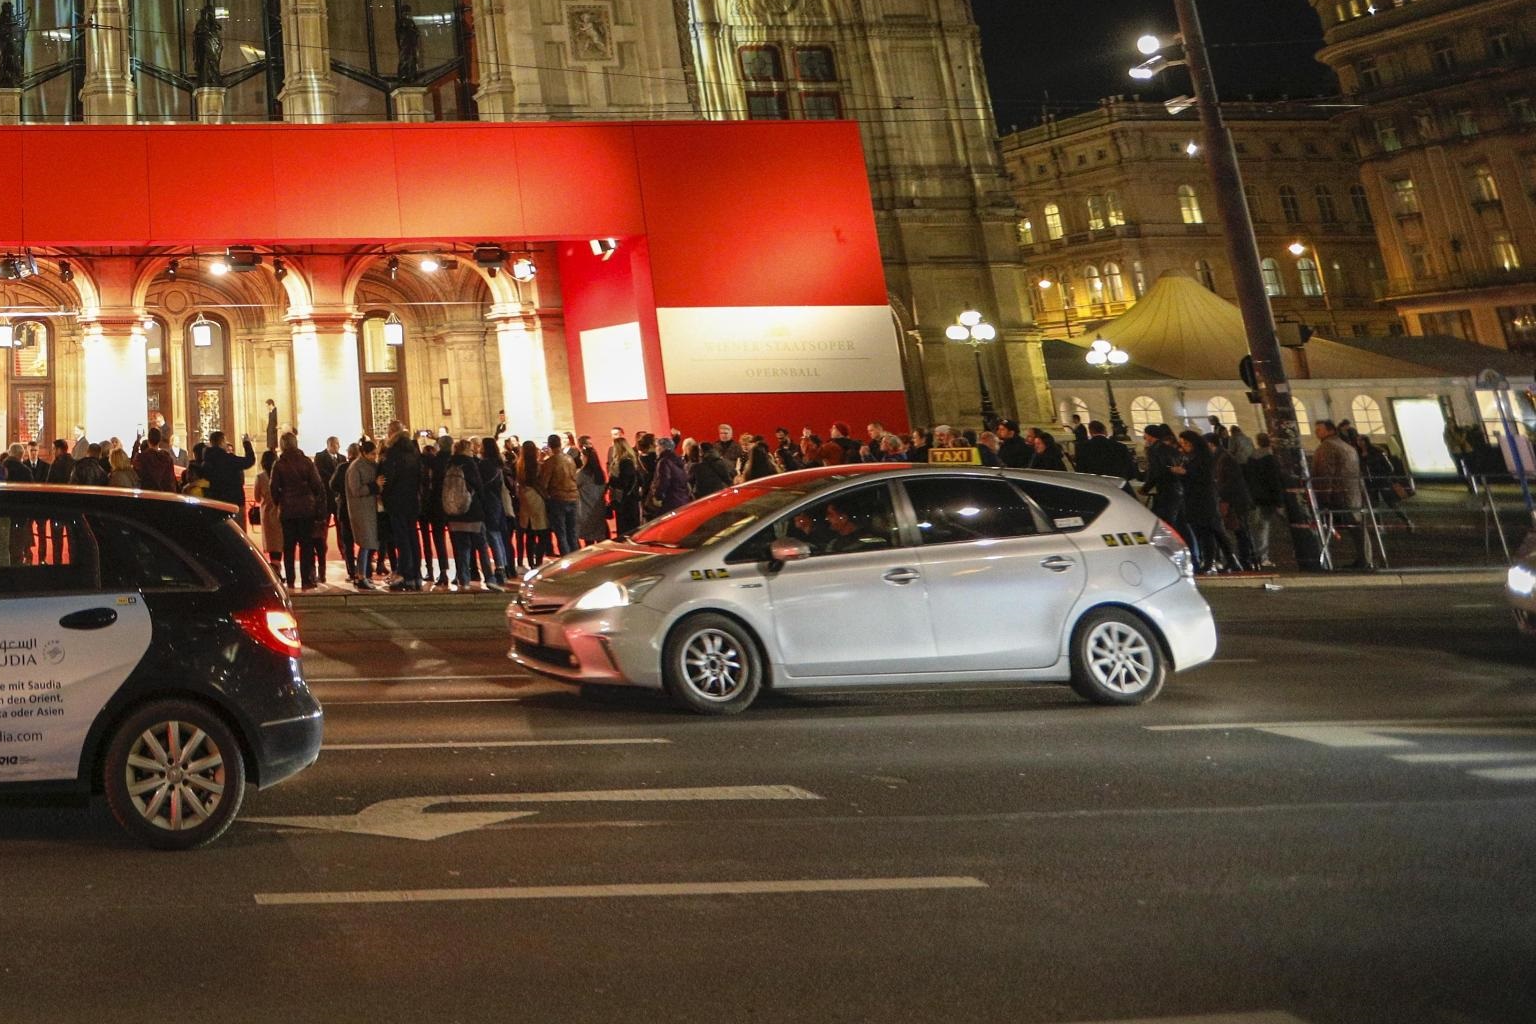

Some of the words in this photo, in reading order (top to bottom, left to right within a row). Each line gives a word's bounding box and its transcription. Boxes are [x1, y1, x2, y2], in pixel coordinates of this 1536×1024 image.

[765, 340, 856, 352] STAATSOPER
[745, 367, 820, 377] OPERNBALL
[933, 451, 968, 462] TAXI
[8, 680, 25, 691] mit
[28, 679, 62, 690] Saudia
[7, 694, 26, 705] den
[10, 707, 33, 718] oder
[37, 706, 64, 717] Asien
